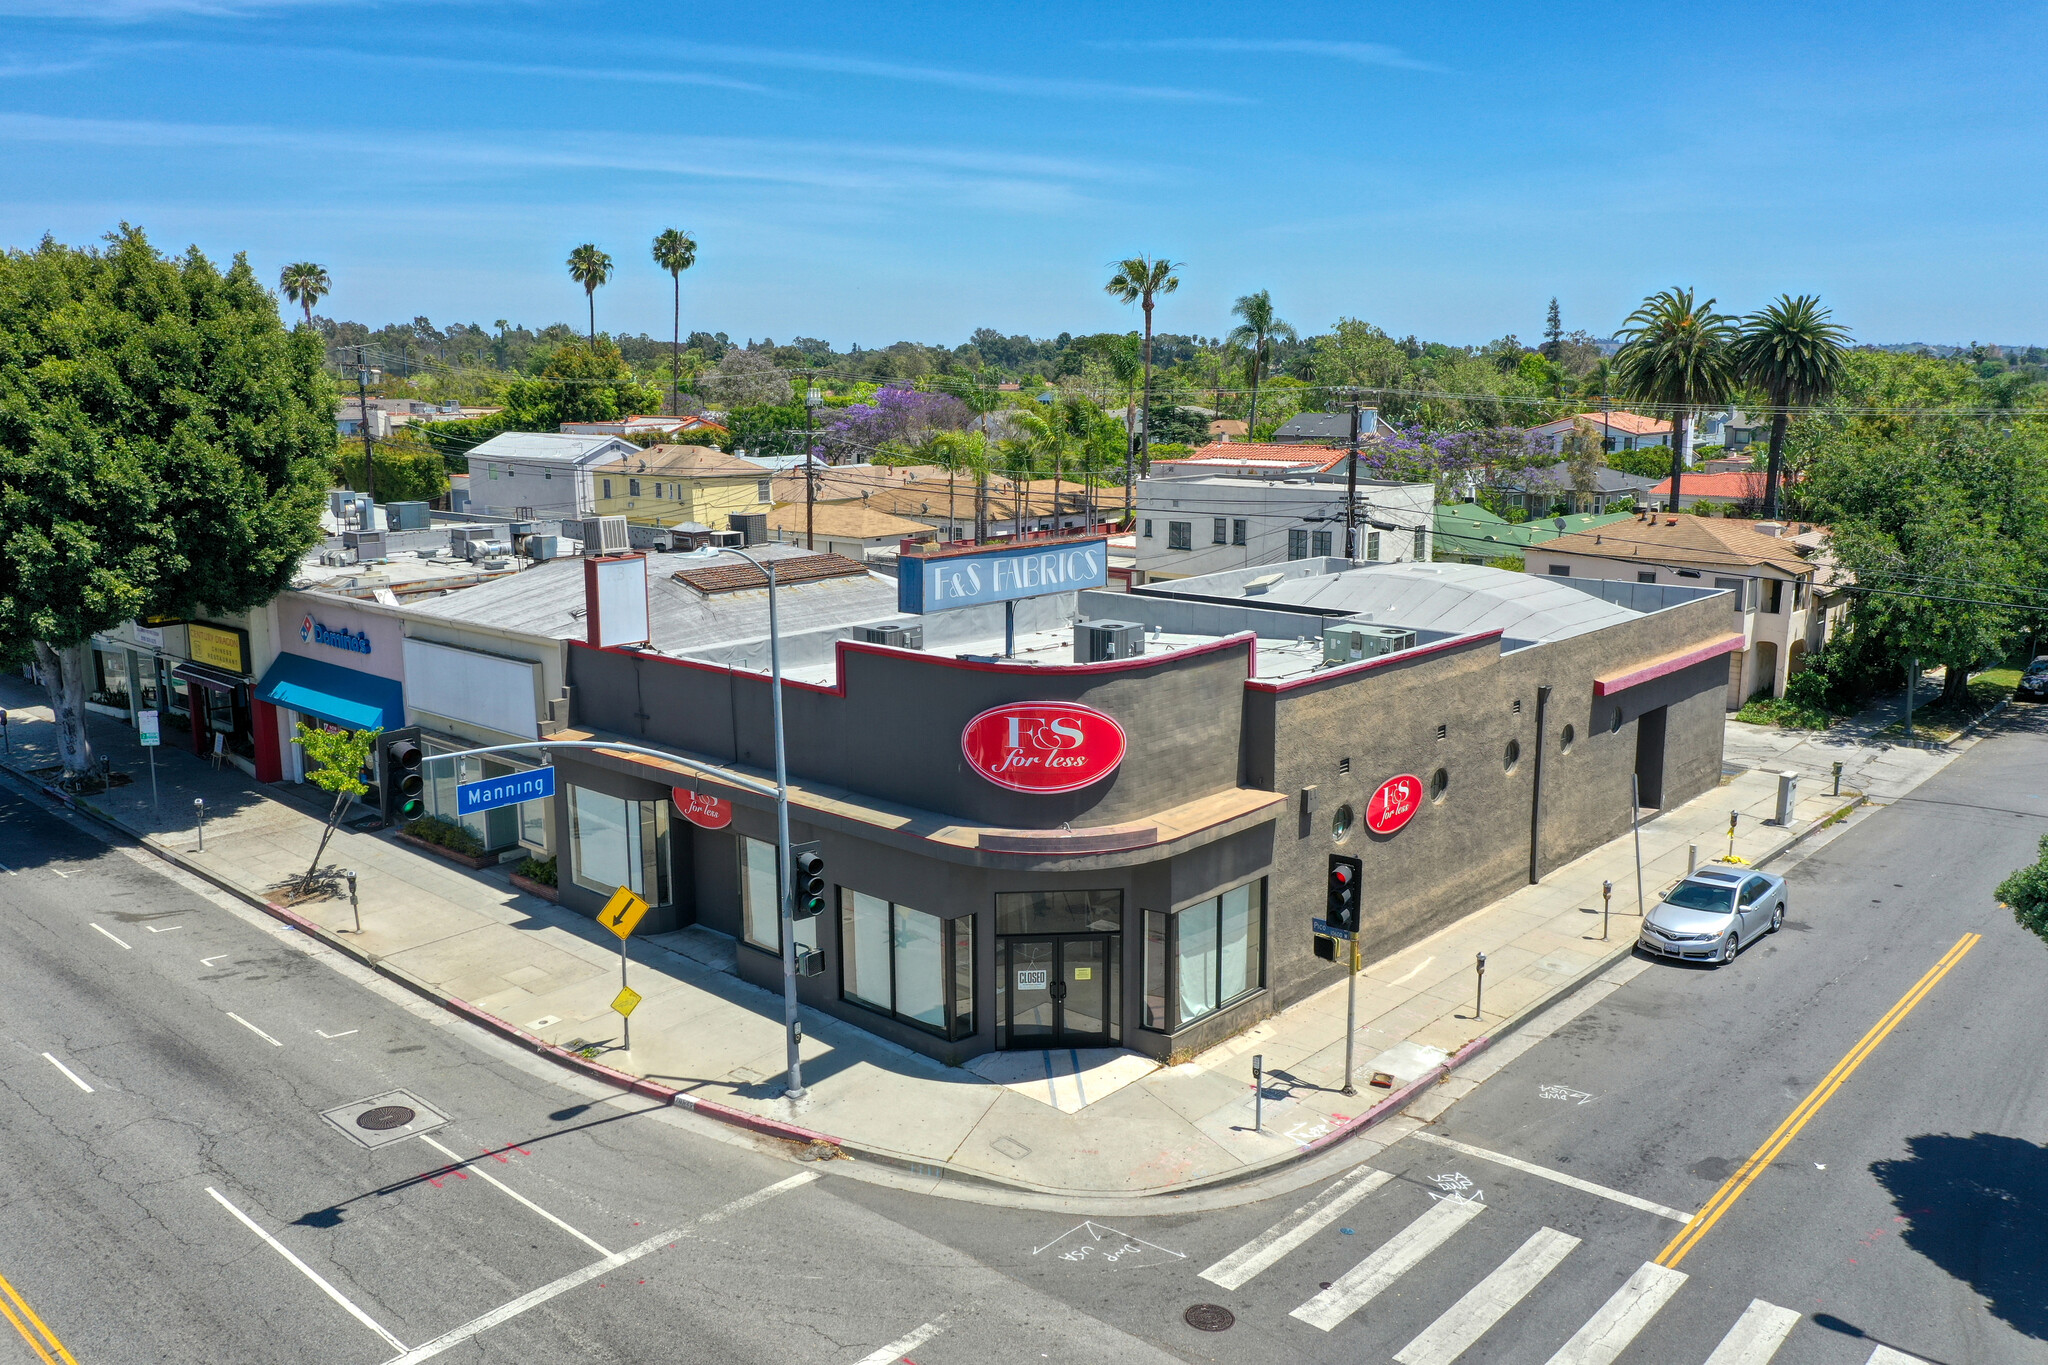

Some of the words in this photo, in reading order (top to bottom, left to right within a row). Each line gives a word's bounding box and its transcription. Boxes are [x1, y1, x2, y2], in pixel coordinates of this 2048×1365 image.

[934, 563, 981, 600] F&S
[993, 550, 1098, 592] FABRICS
[314, 624, 371, 655] Domino's
[207, 652, 238, 665] RESTAURANT
[211, 646, 232, 656] CHINESE
[1004, 716, 1084, 750] F&S
[991, 749, 1041, 772] for
[1044, 749, 1088, 768] less
[468, 779, 543, 805] Manning
[1383, 780, 1410, 808] F&S
[684, 800, 703, 814] for
[703, 804, 719, 818] less
[1376, 807, 1395, 828] for
[1395, 801, 1410, 815] less
[1313, 921, 1327, 931] Pico
[1019, 972, 1045, 984] CLOSED
[1427, 1172, 1470, 1182] USA
[1058, 1246, 1094, 1261] USA
